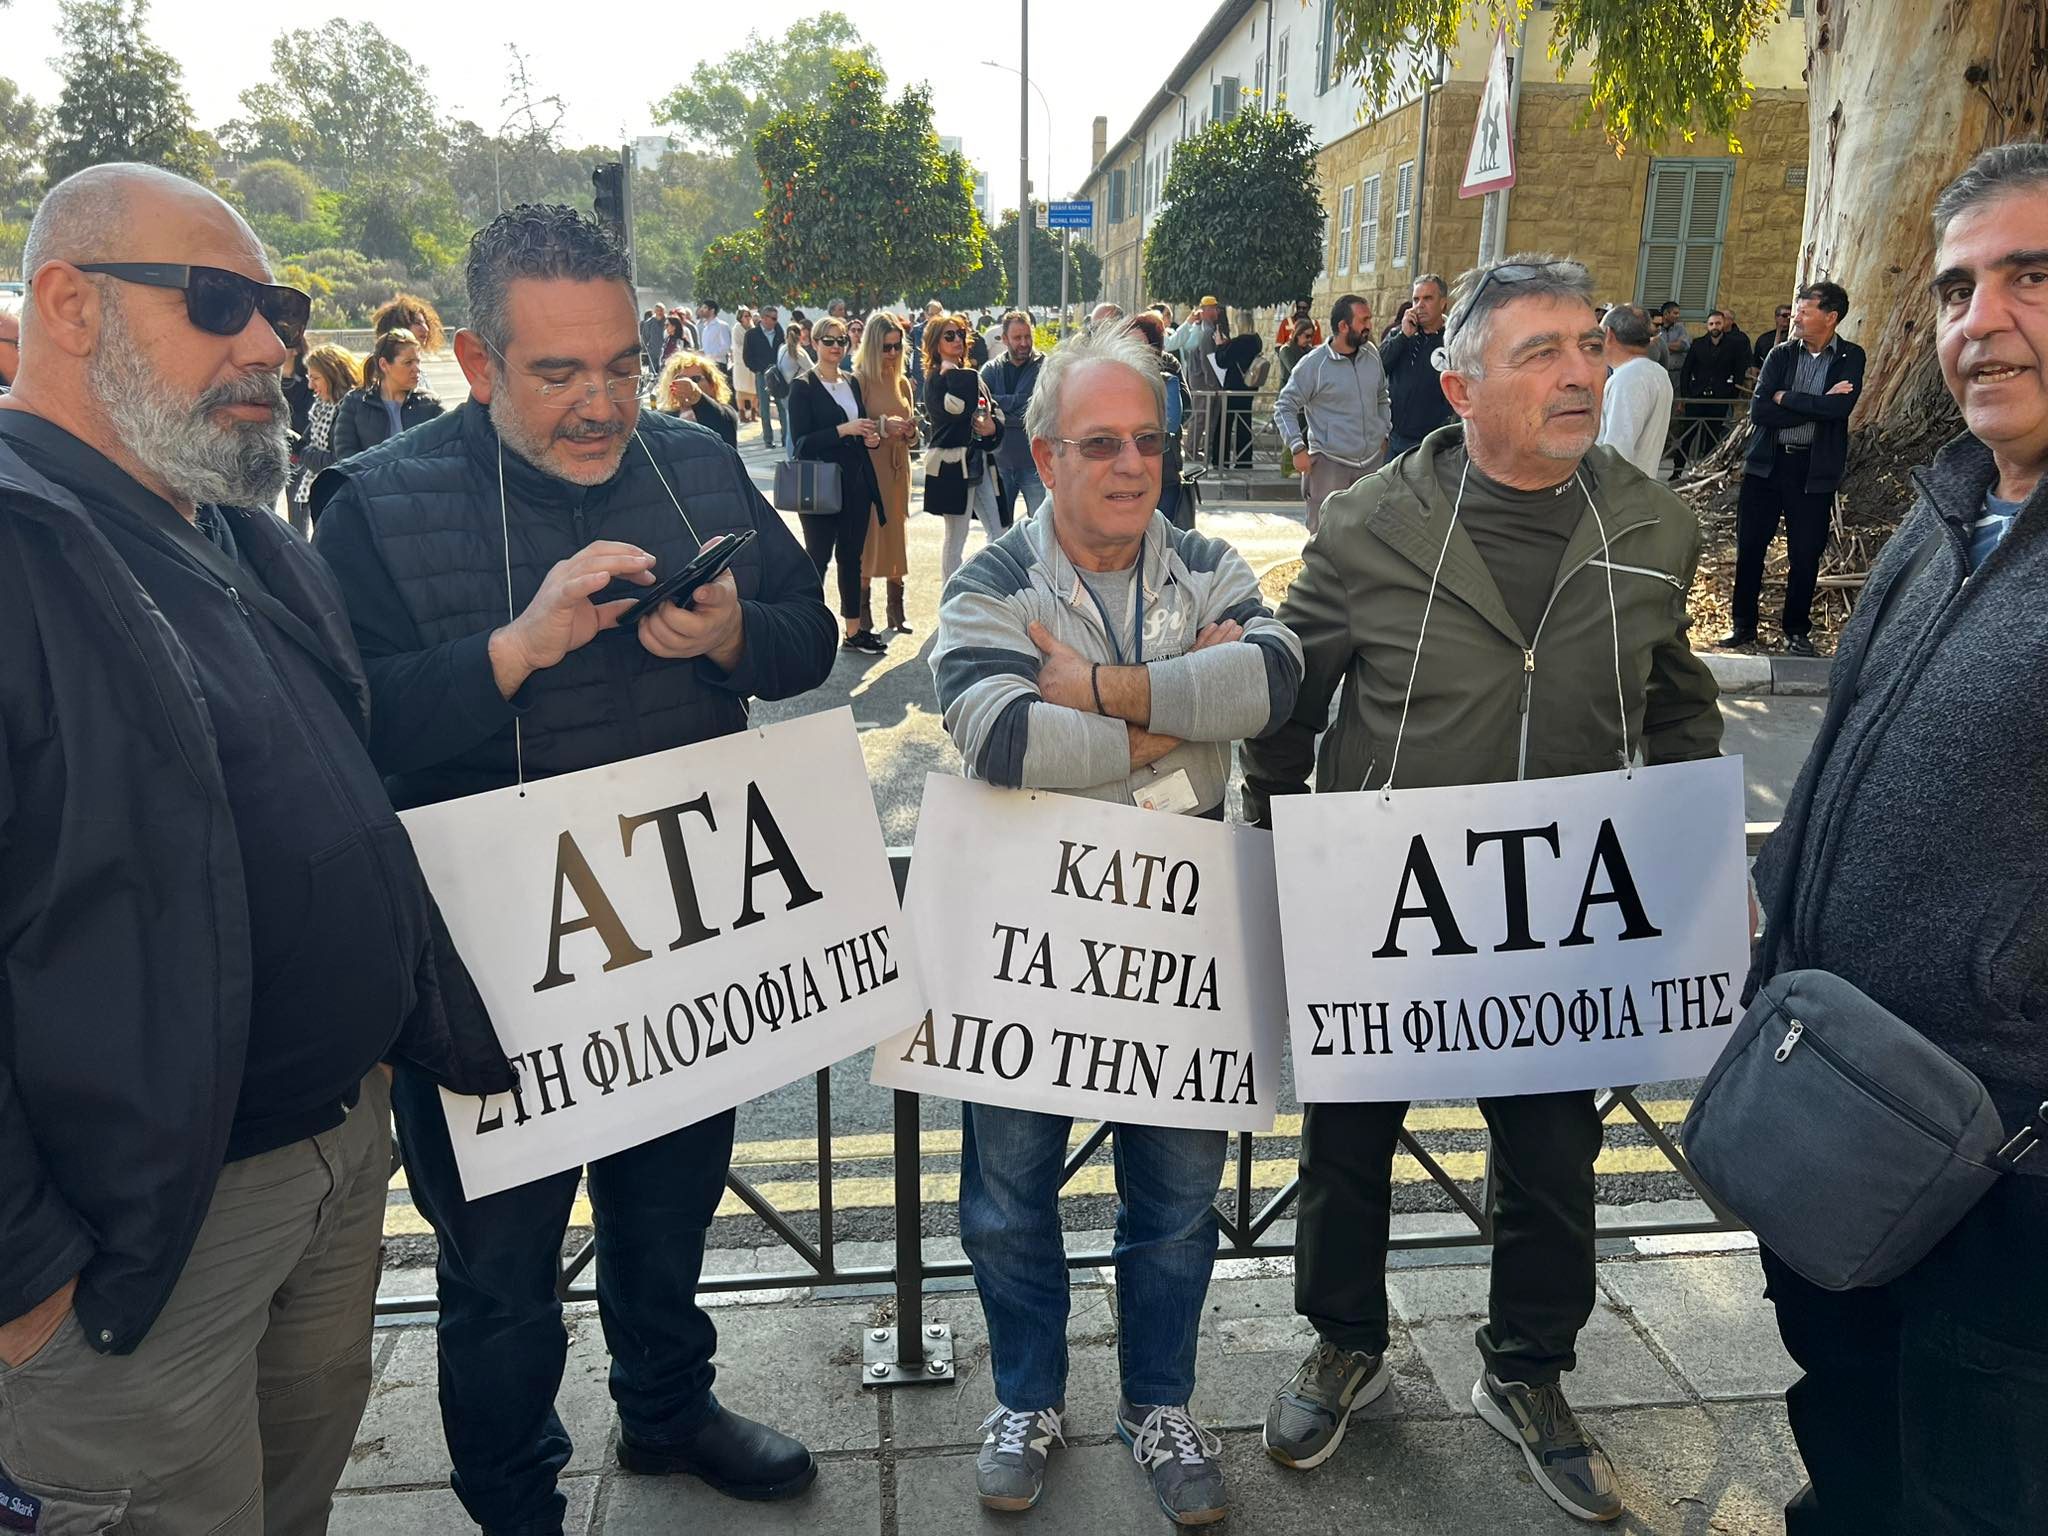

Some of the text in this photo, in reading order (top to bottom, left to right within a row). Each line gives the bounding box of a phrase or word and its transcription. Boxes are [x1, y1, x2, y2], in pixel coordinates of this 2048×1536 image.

[532, 780, 823, 993] ΑΤΑ
[1050, 840, 1200, 916] ΚΑΤΩ
[1371, 817, 1662, 958] ΑΤΑ
[582, 957, 828, 1096] ΦΙΛΟΣΟΦΙΑ
[824, 925, 900, 1003] ΤΗΣ
[992, 922, 1222, 1011] ΤΑ ΧΕΡΙΑ
[899, 1008, 1258, 1105] ΑΠΟ ΤΗΝ ΑΤΑ
[1306, 972, 1734, 1056] ΣΤΗ ΦΙΛΟΣΟΦΙΑ ΤΗΣ
[10, 1497, 34, 1517] Shark
